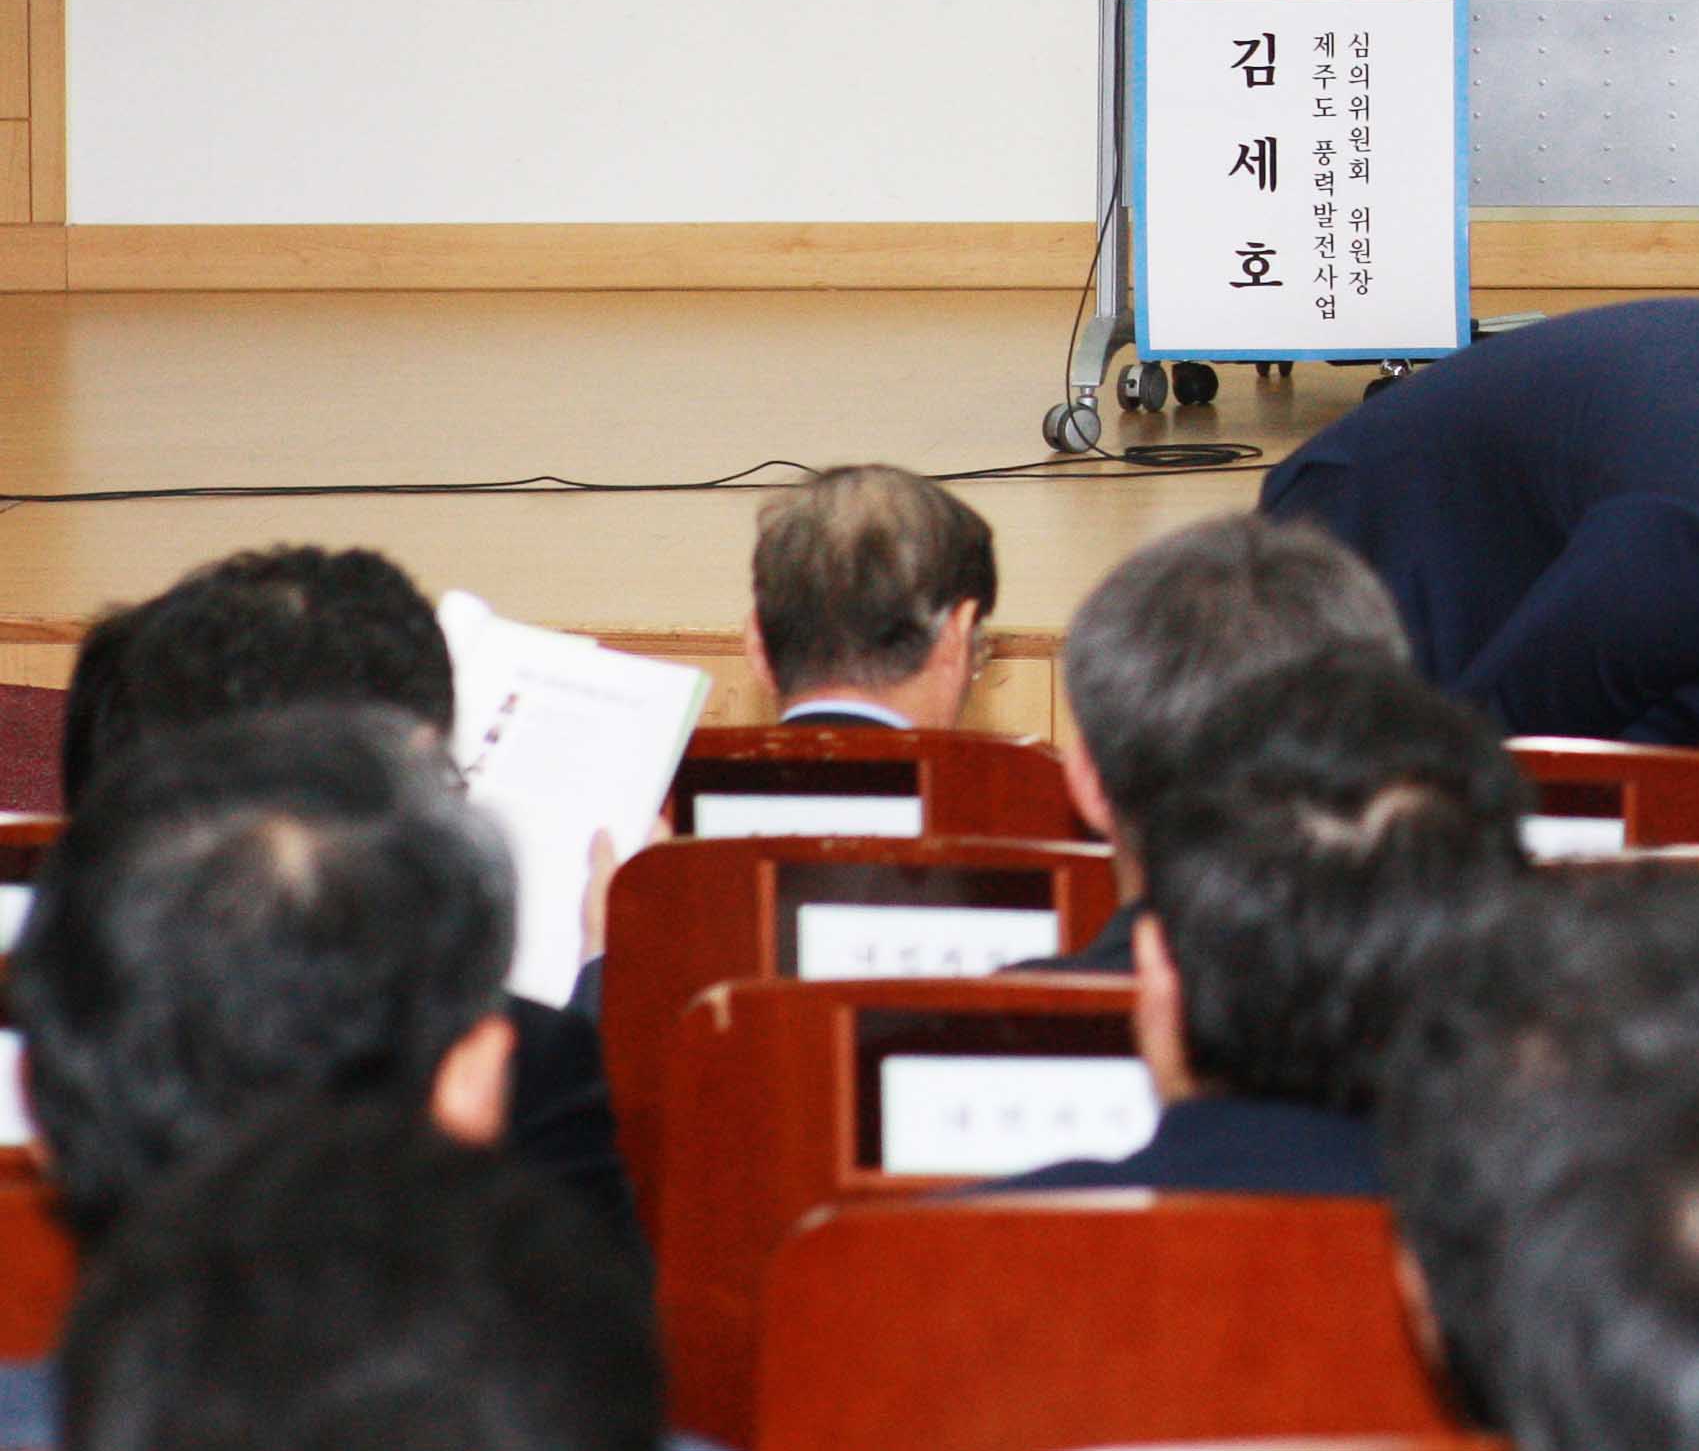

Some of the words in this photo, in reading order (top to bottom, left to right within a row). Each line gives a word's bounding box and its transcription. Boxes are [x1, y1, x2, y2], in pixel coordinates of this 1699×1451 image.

[1312, 31, 1338, 119] 제주도
[1347, 31, 1373, 185] 심의위원회
[1312, 140, 1339, 321] 풍력발전사업
[1347, 205, 1374, 297] 위원장
